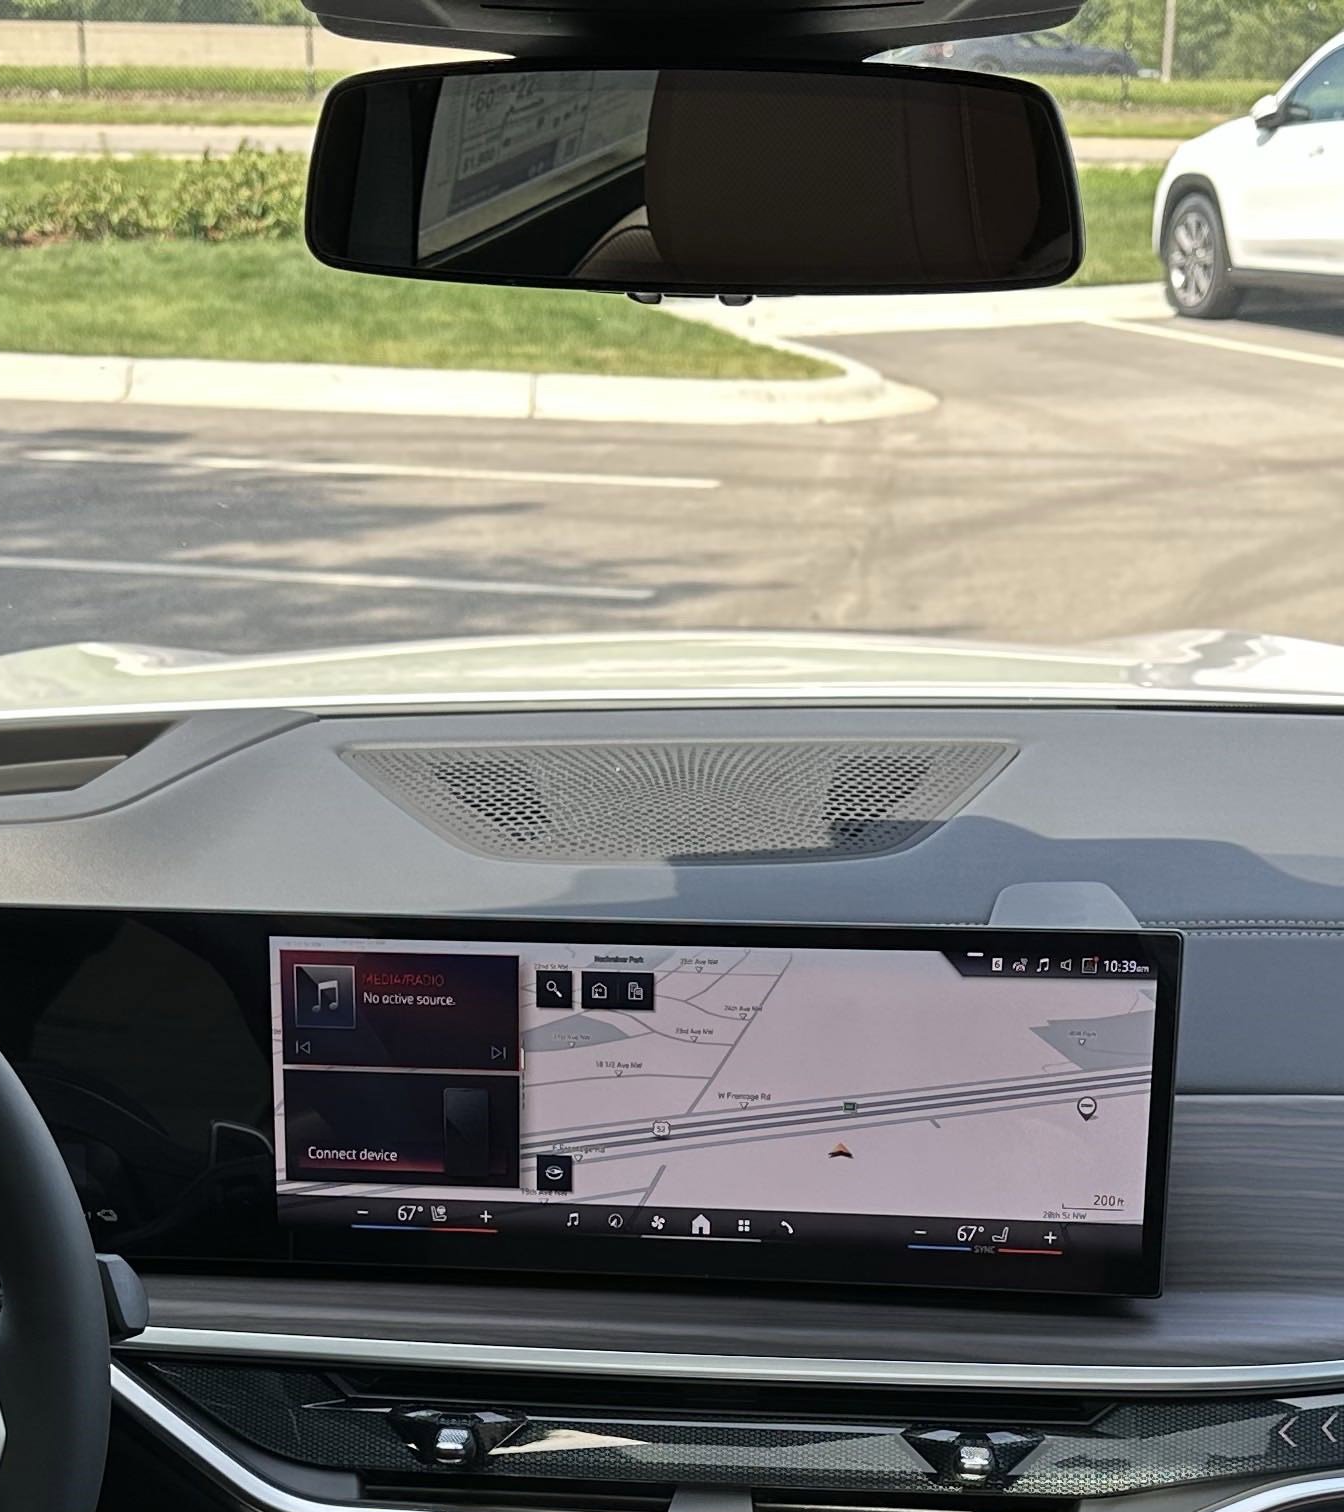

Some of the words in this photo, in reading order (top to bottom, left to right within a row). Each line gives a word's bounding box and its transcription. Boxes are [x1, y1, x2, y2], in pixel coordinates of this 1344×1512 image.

[363, 991, 380, 1004] No
[382, 993, 414, 1005] active
[307, 1146, 357, 1160] Connect
[359, 1148, 398, 1162] device
[1093, 1194, 1116, 1206] 200
